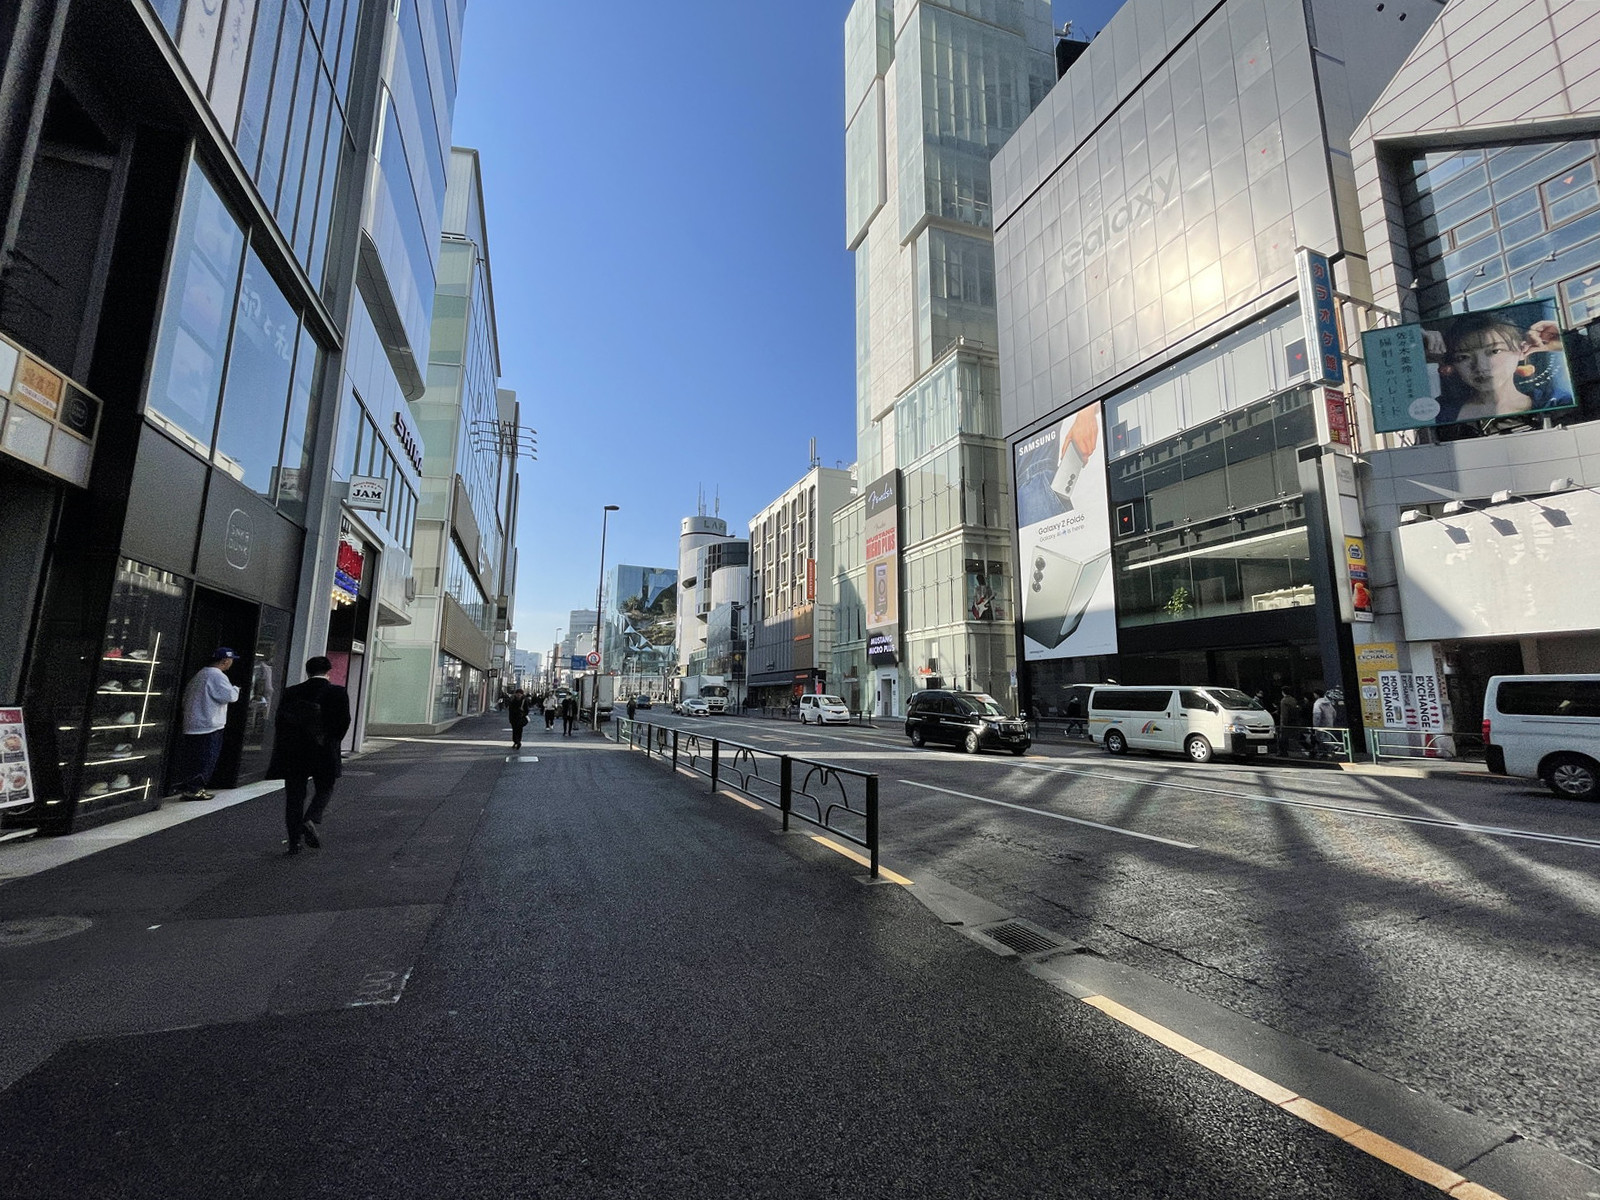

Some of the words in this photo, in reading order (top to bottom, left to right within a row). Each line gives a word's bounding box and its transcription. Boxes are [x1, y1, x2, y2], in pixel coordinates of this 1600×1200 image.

[1313, 262, 1337, 371] カラオケ館
[1018, 430, 1057, 456] SAMSUNG
[352, 489, 382, 499] JAM
[866, 527, 896, 545] MUSTANG
[1038, 522, 1061, 535] Galaxy
[1061, 519, 1066, 528] Z
[1066, 514, 1085, 526] Fold6
[869, 645, 883, 654] MICRO
[883, 645, 896, 653] PLUS
[870, 635, 893, 645] MUSTANG
[1381, 676, 1395, 724] EXCHANGE
[1390, 675, 1399, 702] MONEY
[1415, 675, 1431, 728] EXCHANGE
[1426, 675, 1437, 704] MONEY
